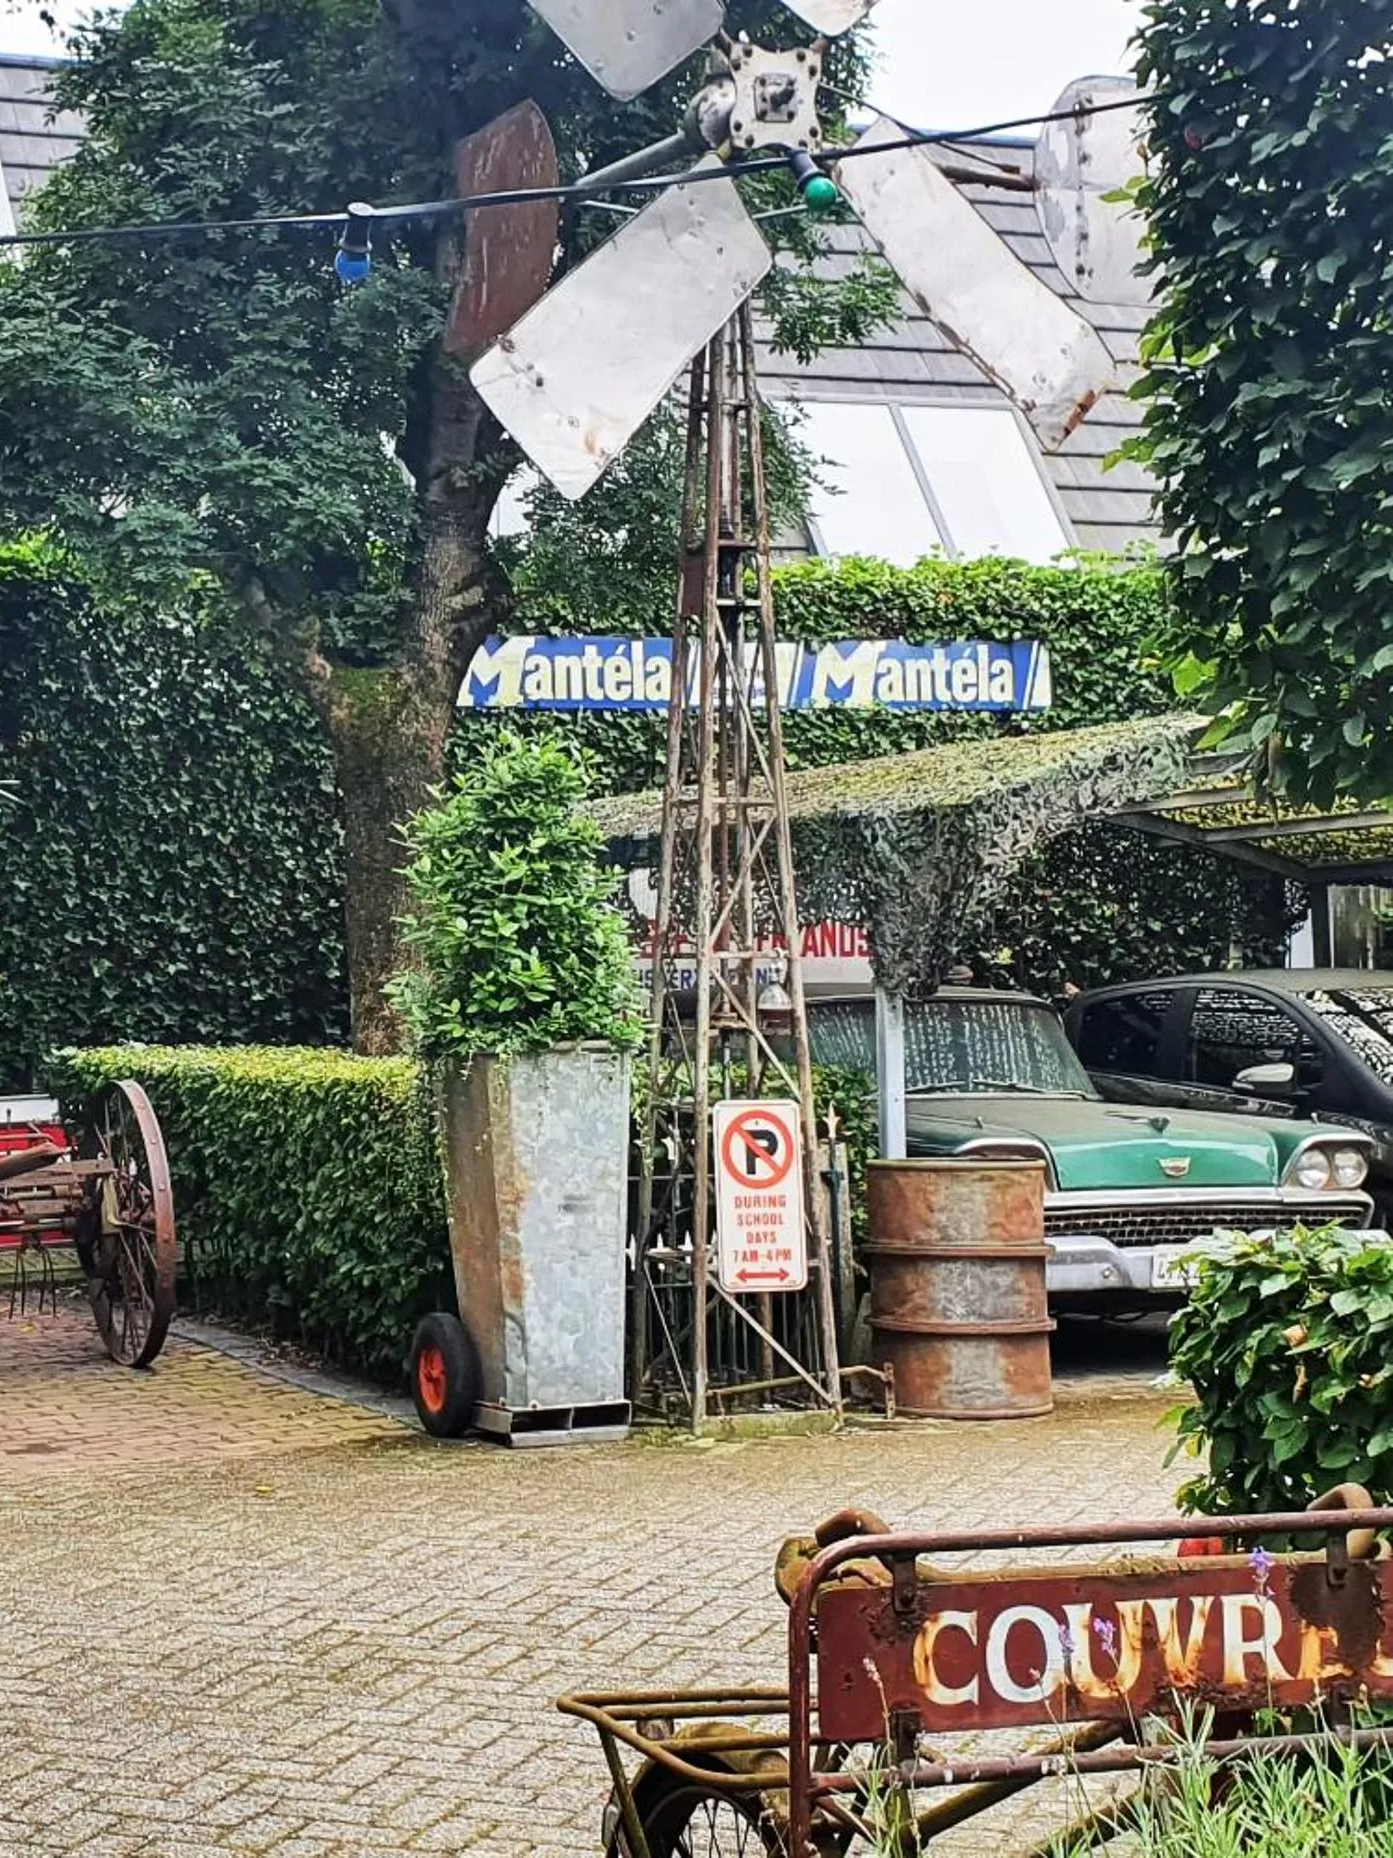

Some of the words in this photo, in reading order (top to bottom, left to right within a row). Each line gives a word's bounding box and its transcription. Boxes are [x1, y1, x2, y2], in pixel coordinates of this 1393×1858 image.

[457, 637, 671, 706] Mantéla
[811, 639, 1014, 706] Mantéla
[734, 1195, 786, 1208] DURING
[737, 1213, 784, 1226] SCHOOL
[746, 1231, 777, 1244] DAYS
